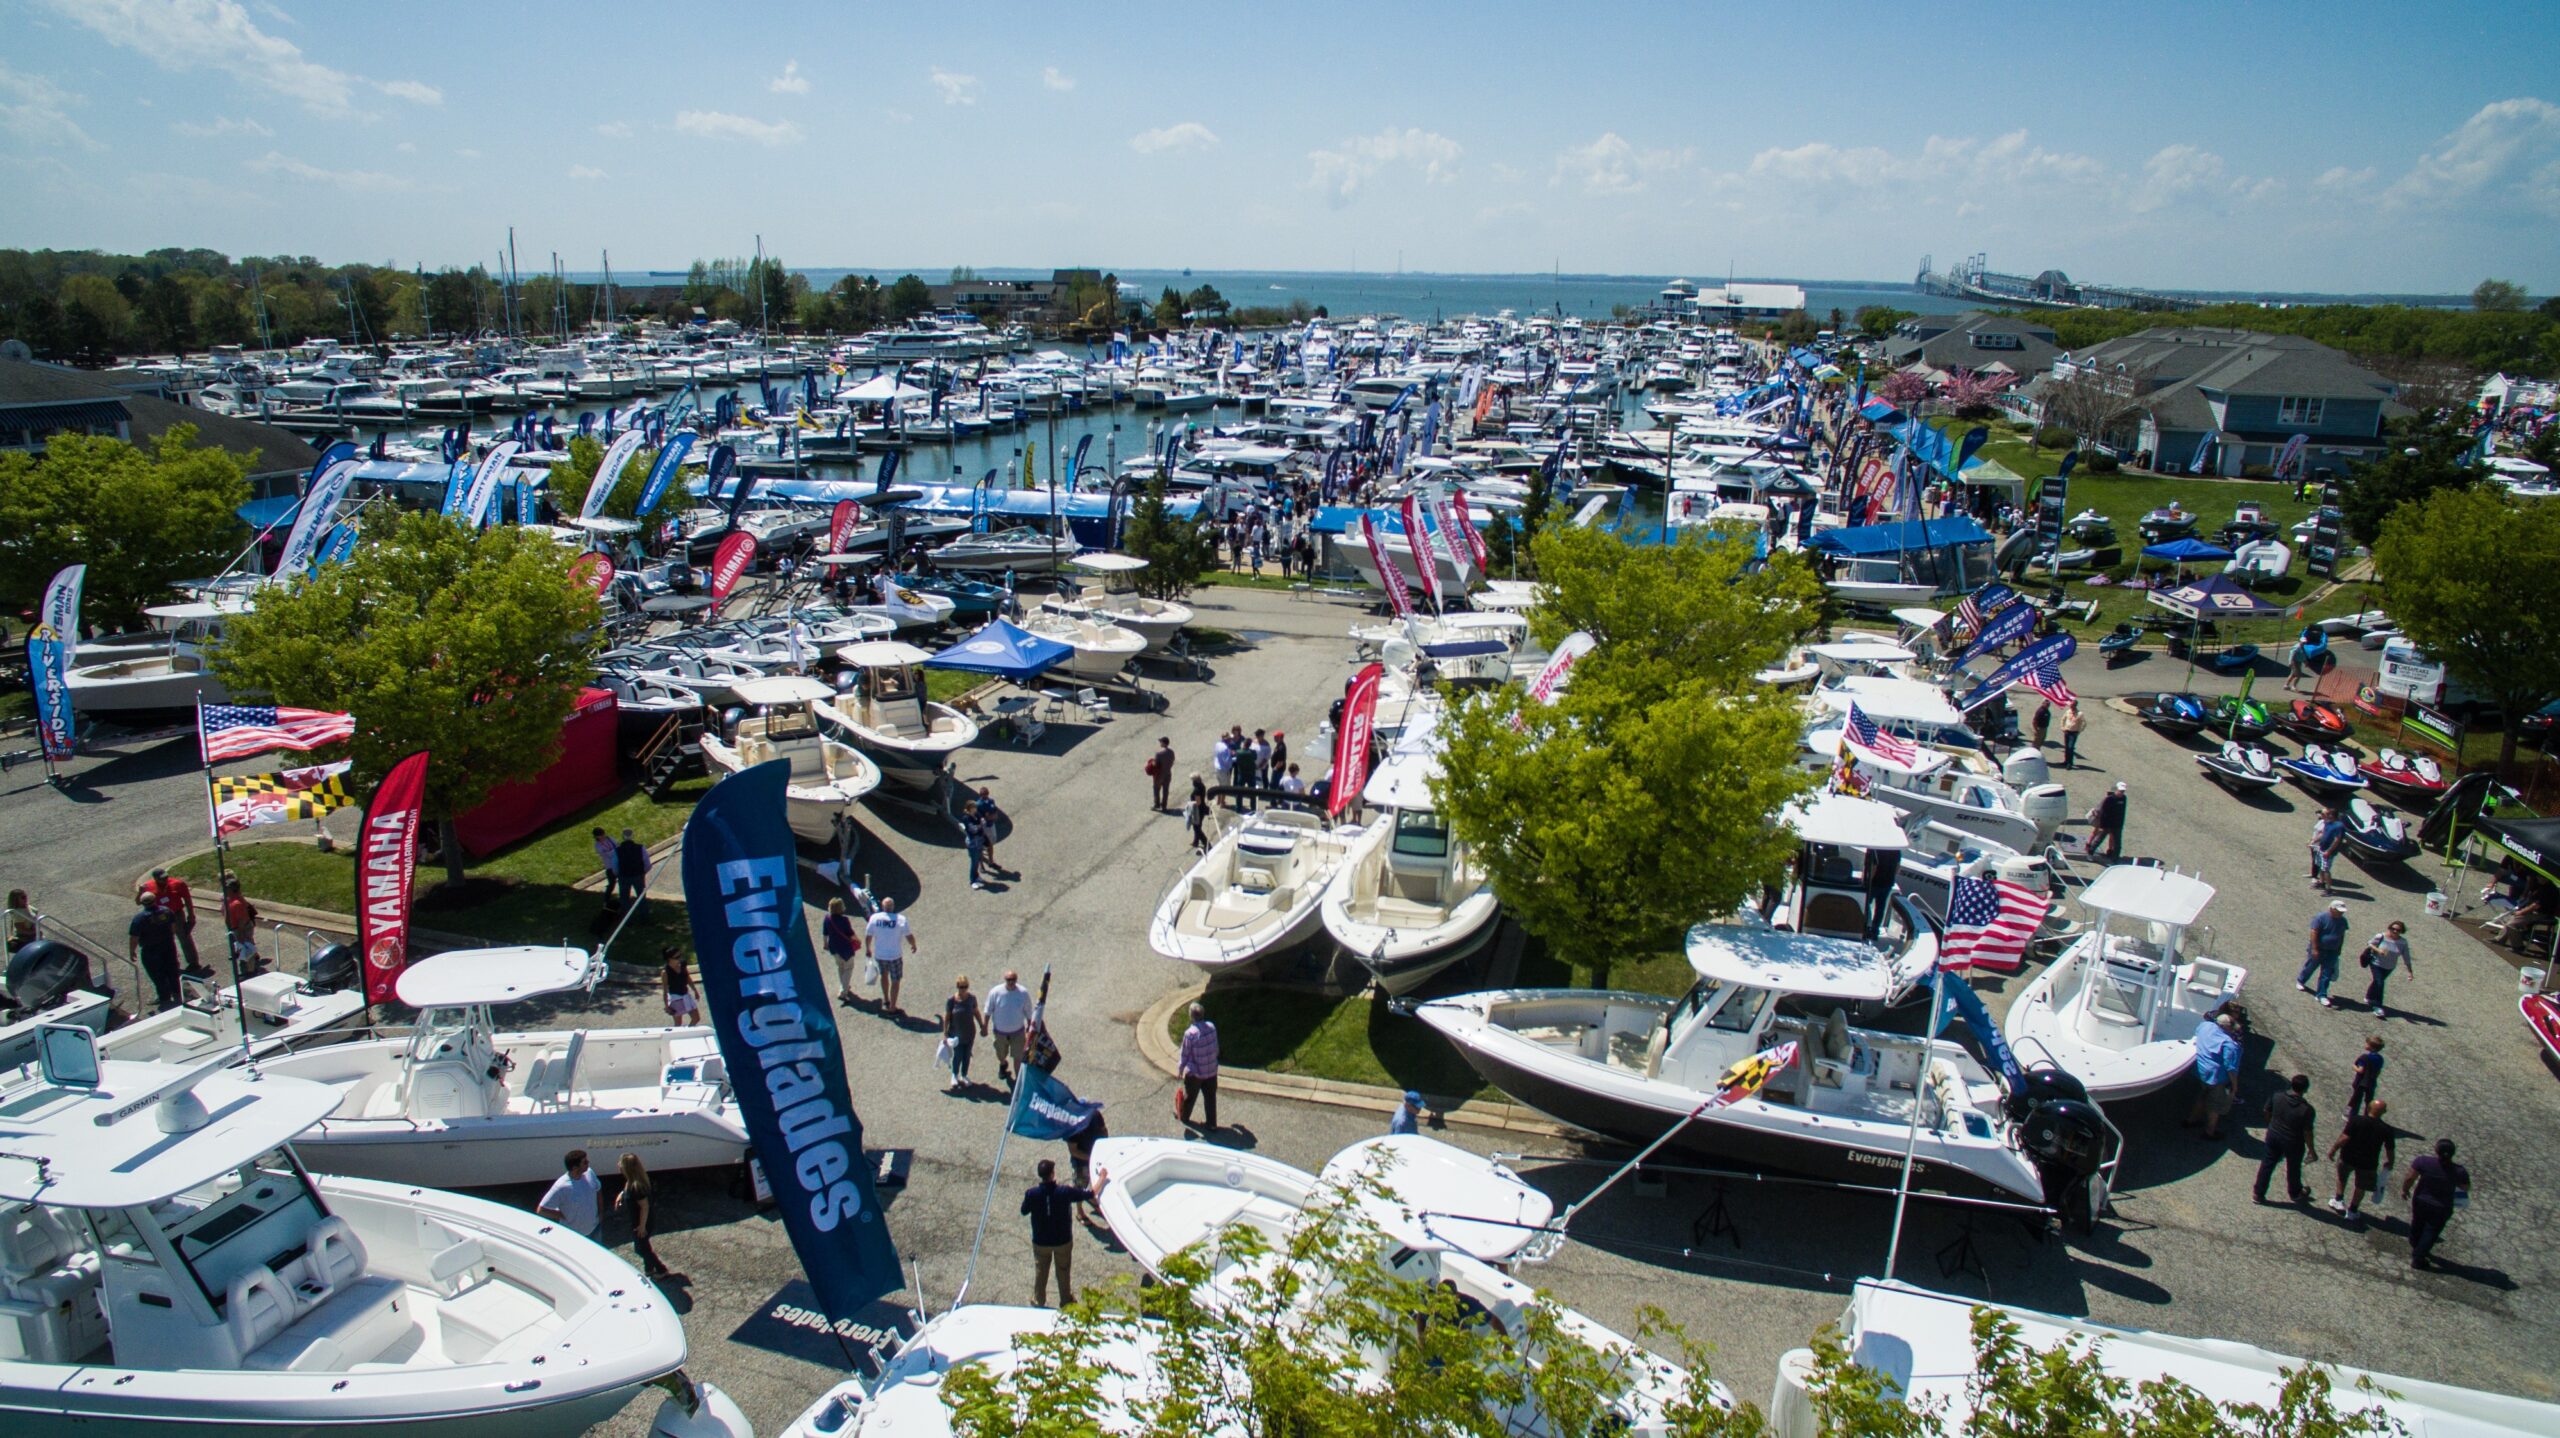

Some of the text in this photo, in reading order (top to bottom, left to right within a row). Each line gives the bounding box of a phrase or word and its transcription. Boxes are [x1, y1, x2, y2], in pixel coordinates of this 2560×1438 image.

[1873, 476, 1892, 501] mjm
[1982, 607, 2031, 643] KEY WEST
[1991, 622, 2023, 645] BOATS
[2010, 638, 2071, 671] KEY WEST
[2021, 652, 2059, 673] BOATS
[39, 627, 68, 744] RIVERSIDE
[2500, 833, 2542, 865] Kawasaki
[367, 810, 407, 937] YAMAHA
[716, 856, 861, 1232] Everglades
[119, 1093, 160, 1118] GARMIN
[1847, 1150, 1926, 1174] Everglaes
